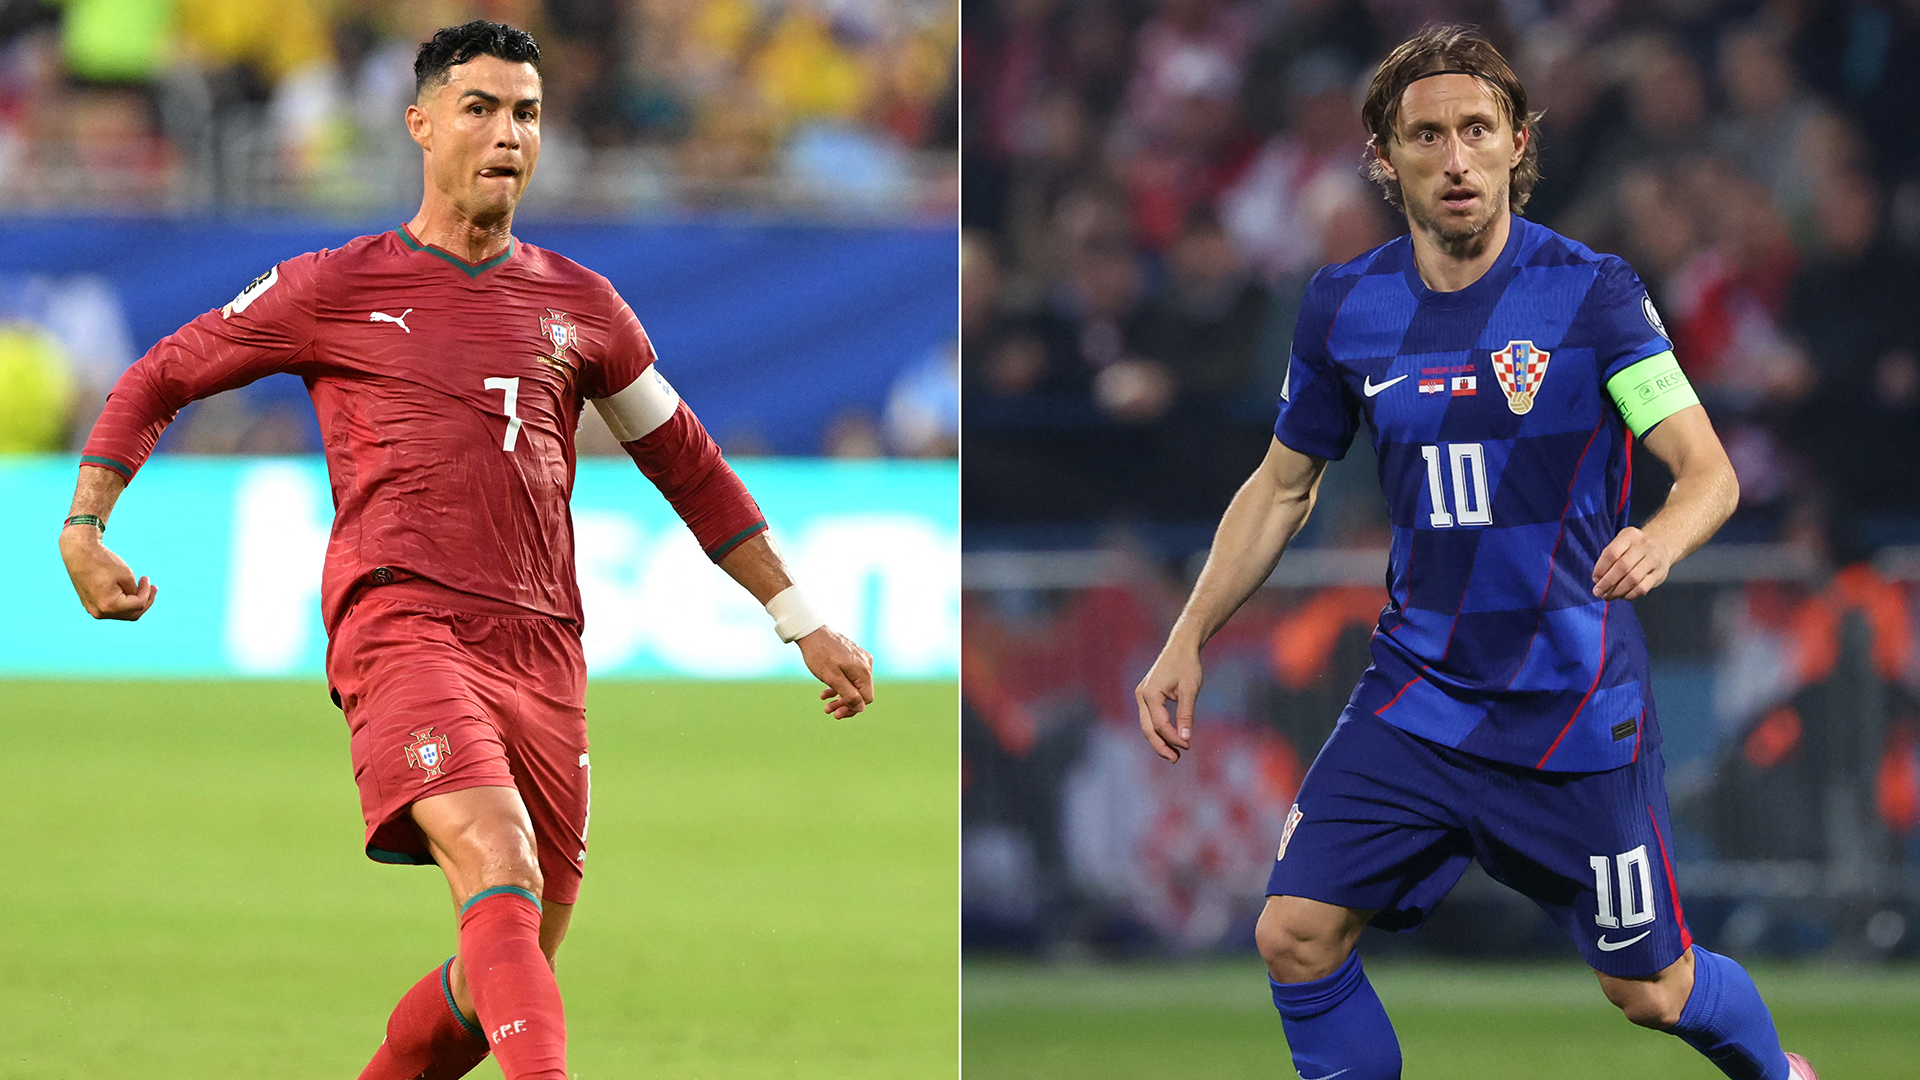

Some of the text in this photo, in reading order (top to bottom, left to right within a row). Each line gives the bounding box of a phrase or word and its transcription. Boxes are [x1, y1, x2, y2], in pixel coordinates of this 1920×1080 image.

[1515, 348, 1526, 385] HNS
[484, 376, 522, 452] 7
[1421, 443, 1493, 528] 10
[1589, 844, 1656, 929] 10
